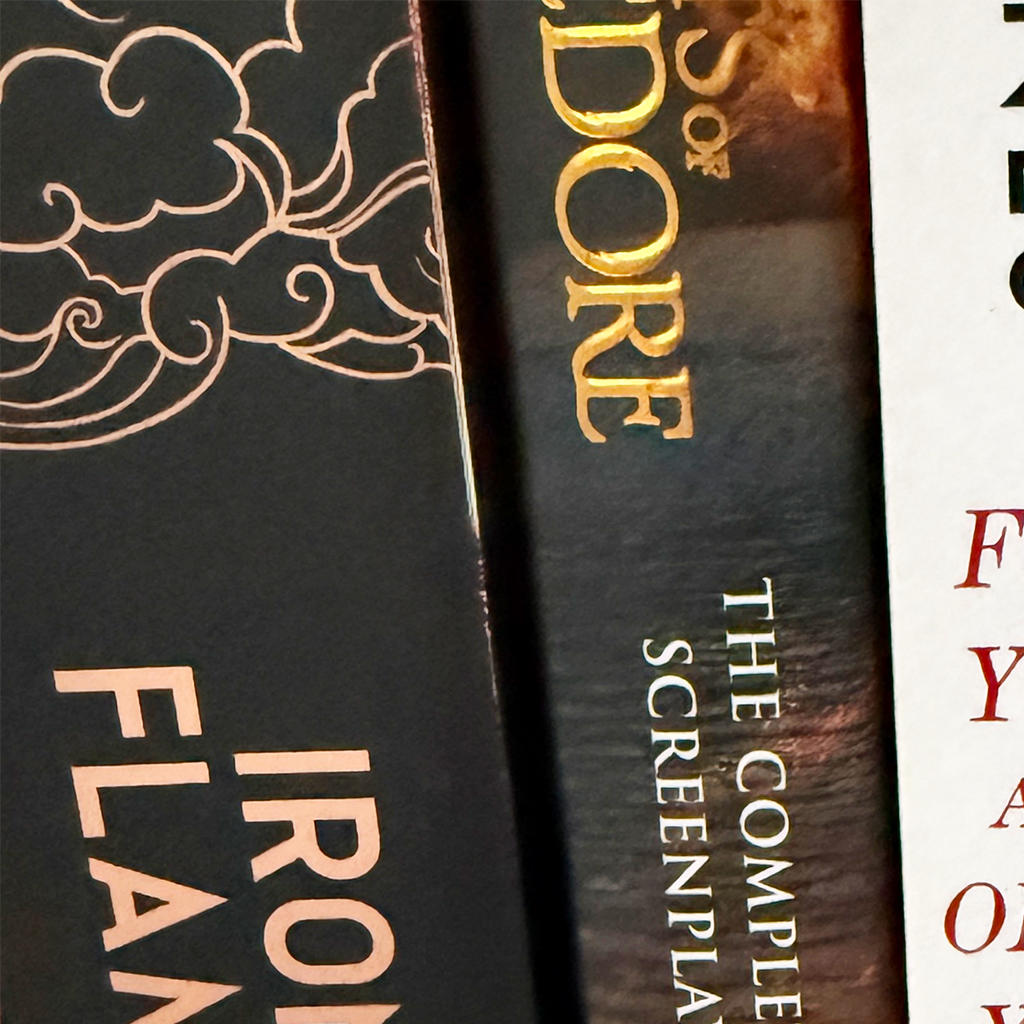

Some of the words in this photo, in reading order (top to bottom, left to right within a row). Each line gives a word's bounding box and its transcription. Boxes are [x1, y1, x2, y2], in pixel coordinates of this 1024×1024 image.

[681, 103, 731, 180] OF
[539, 0, 694, 444] DORE
[723, 577, 781, 724] THE
